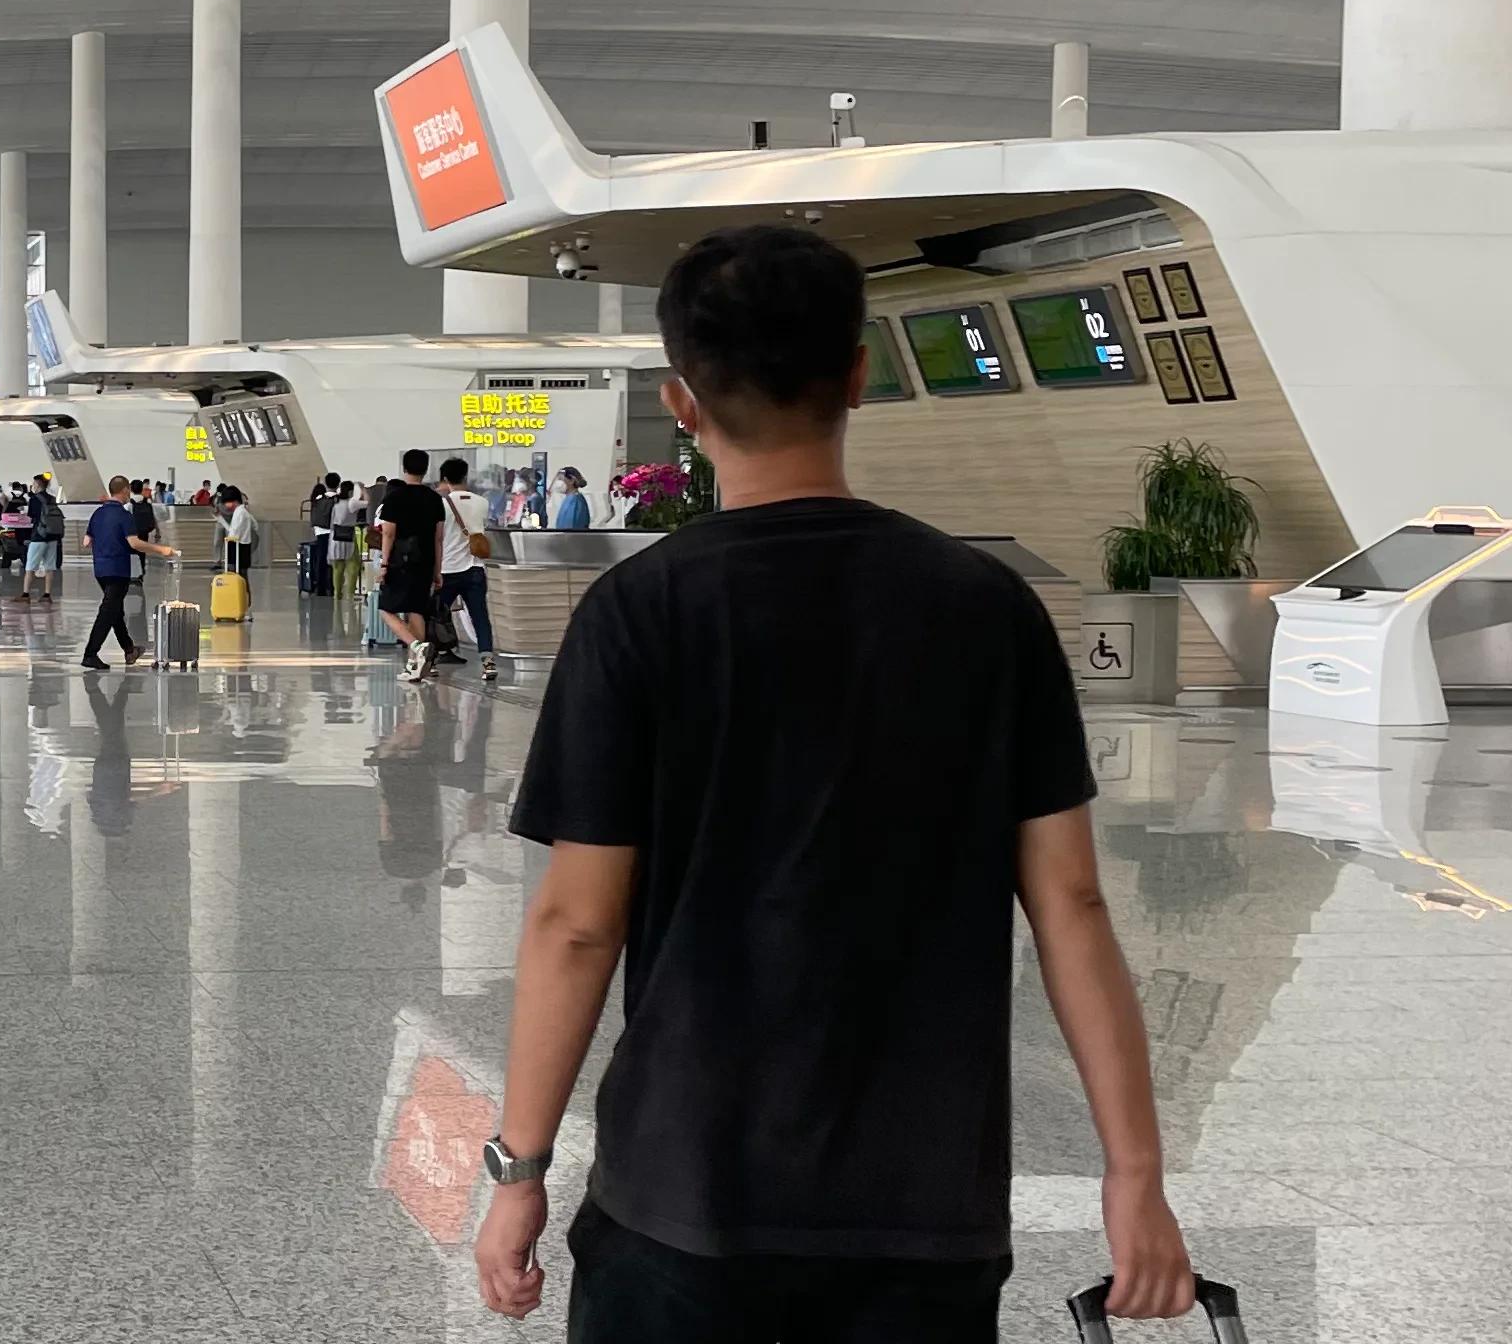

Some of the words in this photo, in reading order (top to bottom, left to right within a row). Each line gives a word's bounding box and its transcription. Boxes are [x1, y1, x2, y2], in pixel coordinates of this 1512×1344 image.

[1085, 312, 1110, 339] 02
[965, 328, 986, 352] 01
[461, 393, 551, 414] 自助托运
[463, 414, 546, 429] Self-service
[464, 430, 493, 447] Bag
[496, 430, 536, 447] Drop
